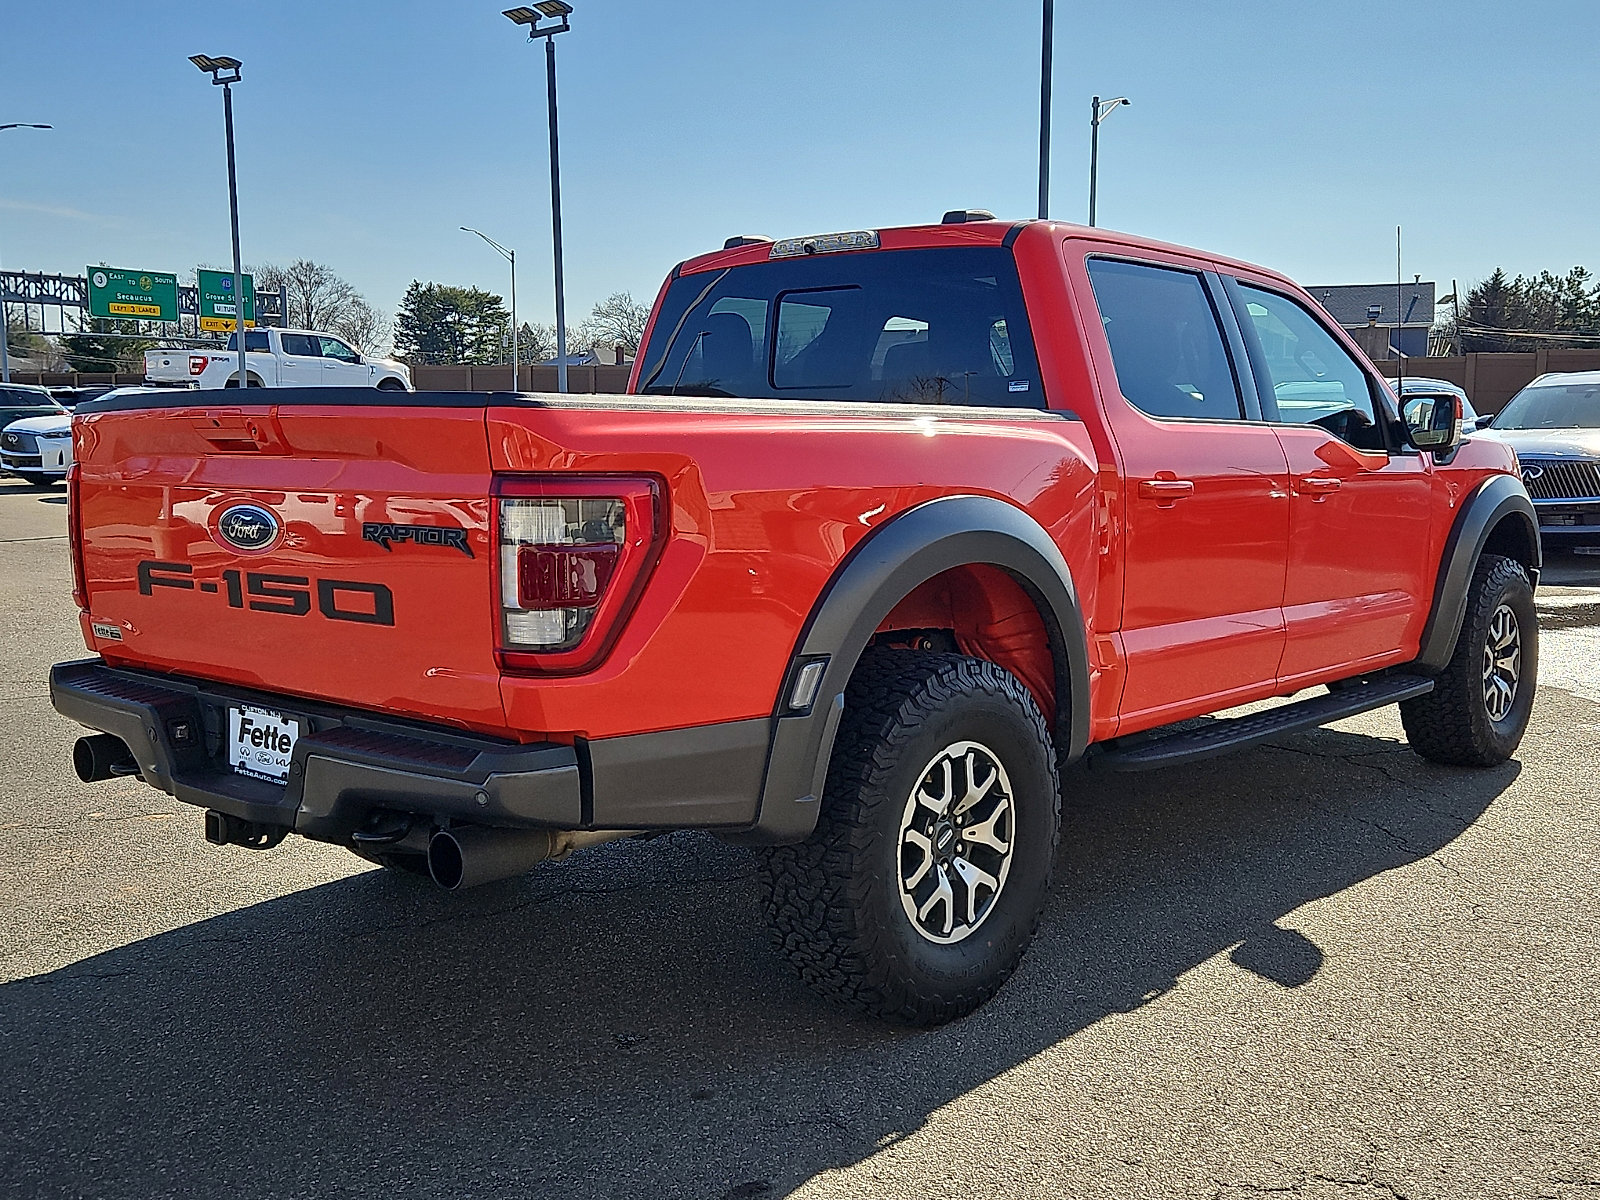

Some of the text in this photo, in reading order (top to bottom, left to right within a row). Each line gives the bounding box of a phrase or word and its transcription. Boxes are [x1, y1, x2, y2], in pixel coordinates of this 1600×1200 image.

[97, 275, 103, 284] 3
[116, 293, 153, 302] Secaucus
[205, 293, 249, 303] Grove Stet
[130, 305, 136, 313] 3
[228, 513, 261, 541] Ford
[362, 521, 475, 559] RAPTOR
[136, 560, 396, 627] F-150
[238, 717, 292, 754] Fette
